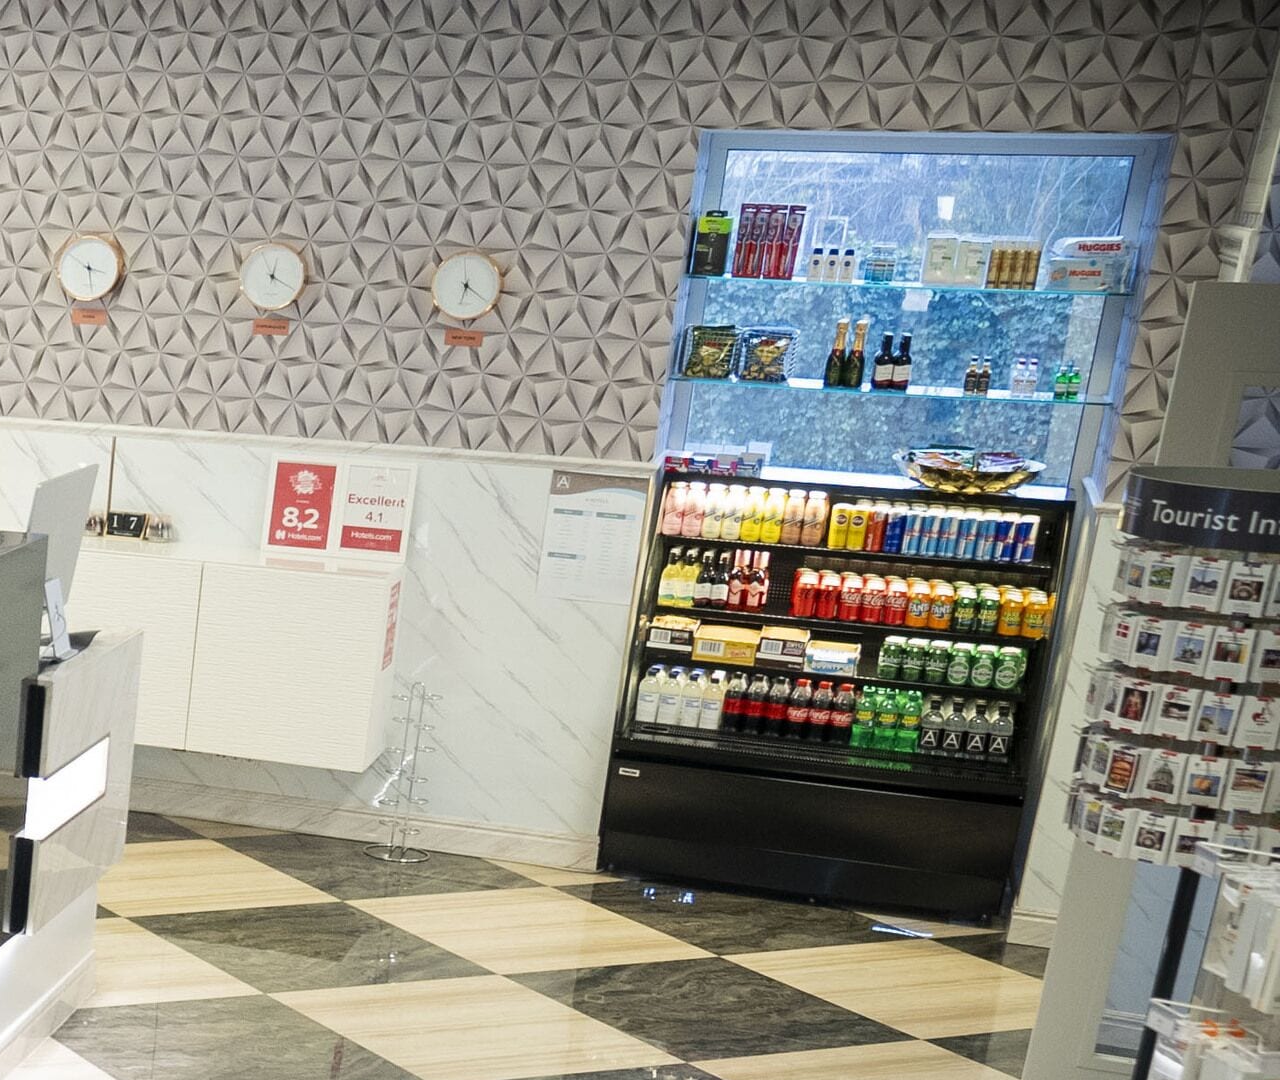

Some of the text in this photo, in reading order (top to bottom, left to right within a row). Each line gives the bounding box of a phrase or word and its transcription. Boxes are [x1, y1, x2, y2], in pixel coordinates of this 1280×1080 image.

[1078, 243, 1121, 251] HUGGIES
[348, 493, 405, 508] Excellent
[129, 517, 138, 530] 7
[282, 506, 319, 532] 8,2
[365, 511, 383, 523] 4.1
[1151, 499, 1240, 532] Tourist
[351, 531, 392, 541] Hotels.com
[921, 730, 938, 747] A
[943, 732, 960, 749] A
[968, 734, 983, 751] A
[989, 737, 1006, 754] A
